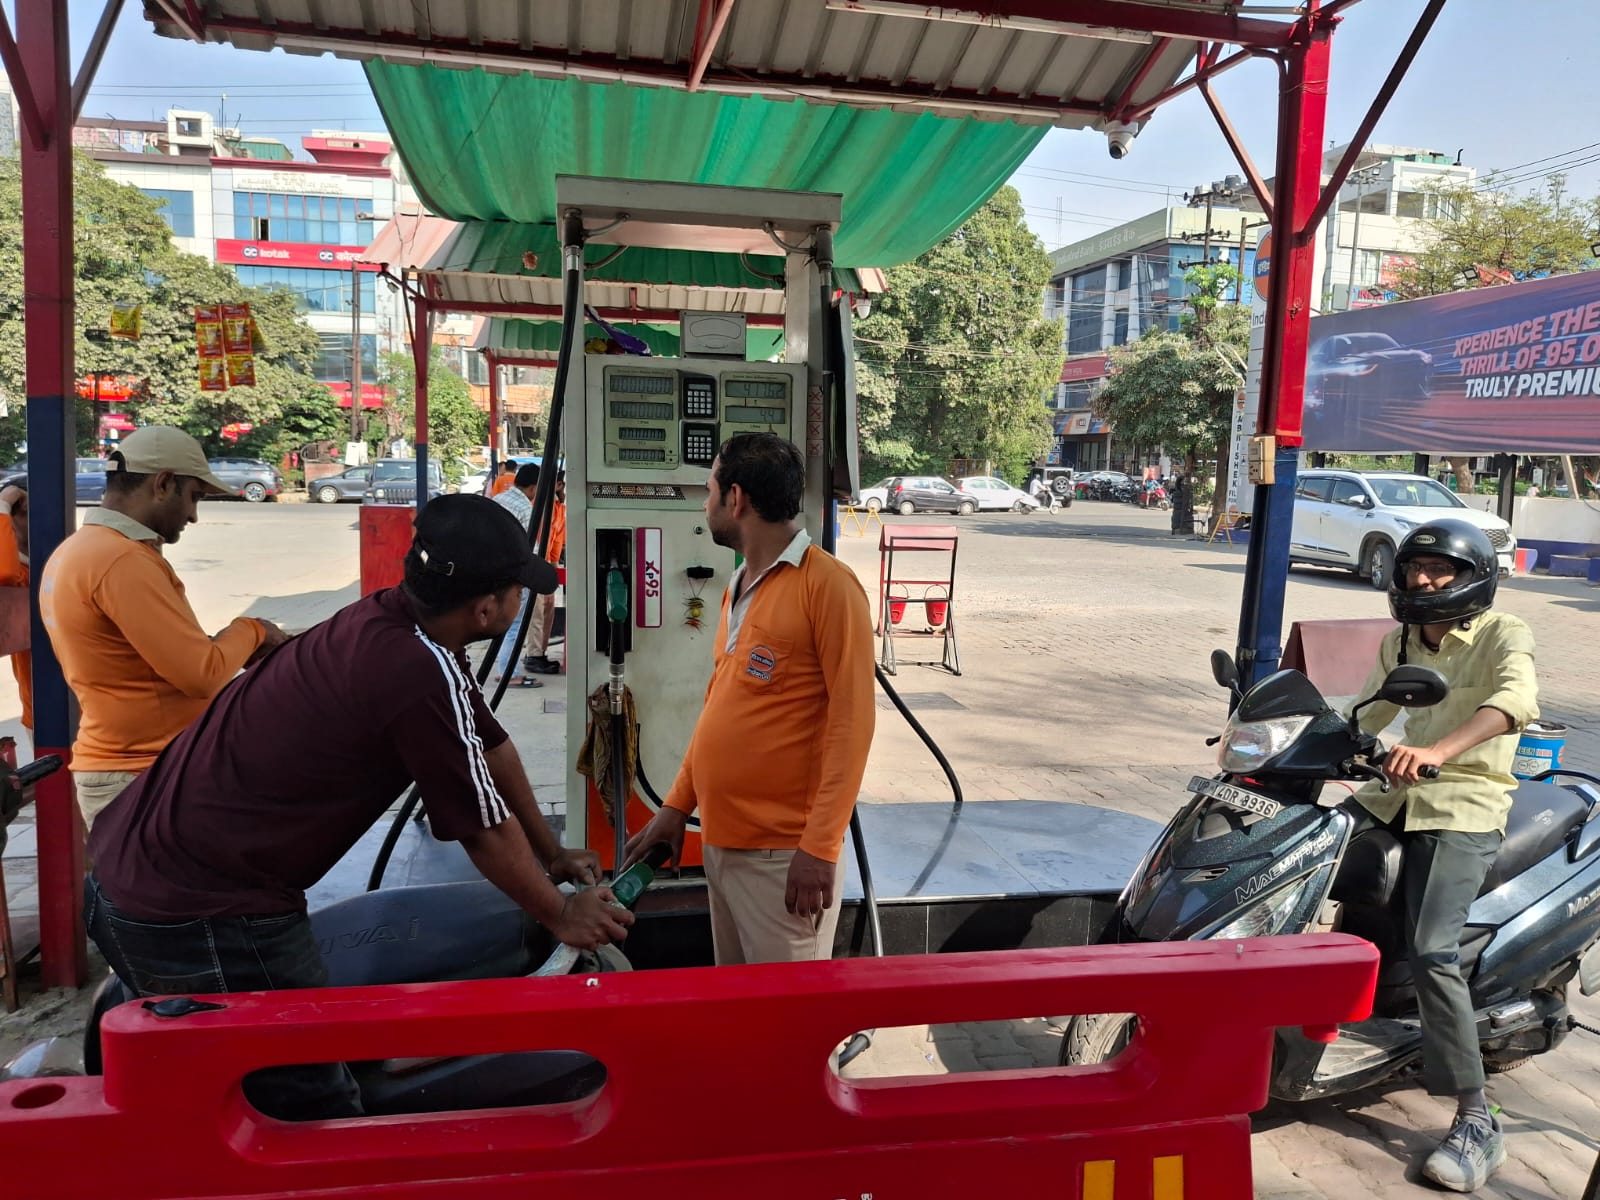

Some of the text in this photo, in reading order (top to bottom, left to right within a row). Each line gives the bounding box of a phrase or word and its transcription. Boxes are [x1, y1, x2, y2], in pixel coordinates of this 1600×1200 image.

[1252, 312, 1265, 326] Ind
[1453, 300, 1600, 358] XPERIENCE THE
[1460, 334, 1600, 376] THRILL OF 95 O
[1465, 367, 1600, 398] TRULY PREMIU
[645, 560, 660, 598] XP95
[1241, 795, 1274, 816] 8936
